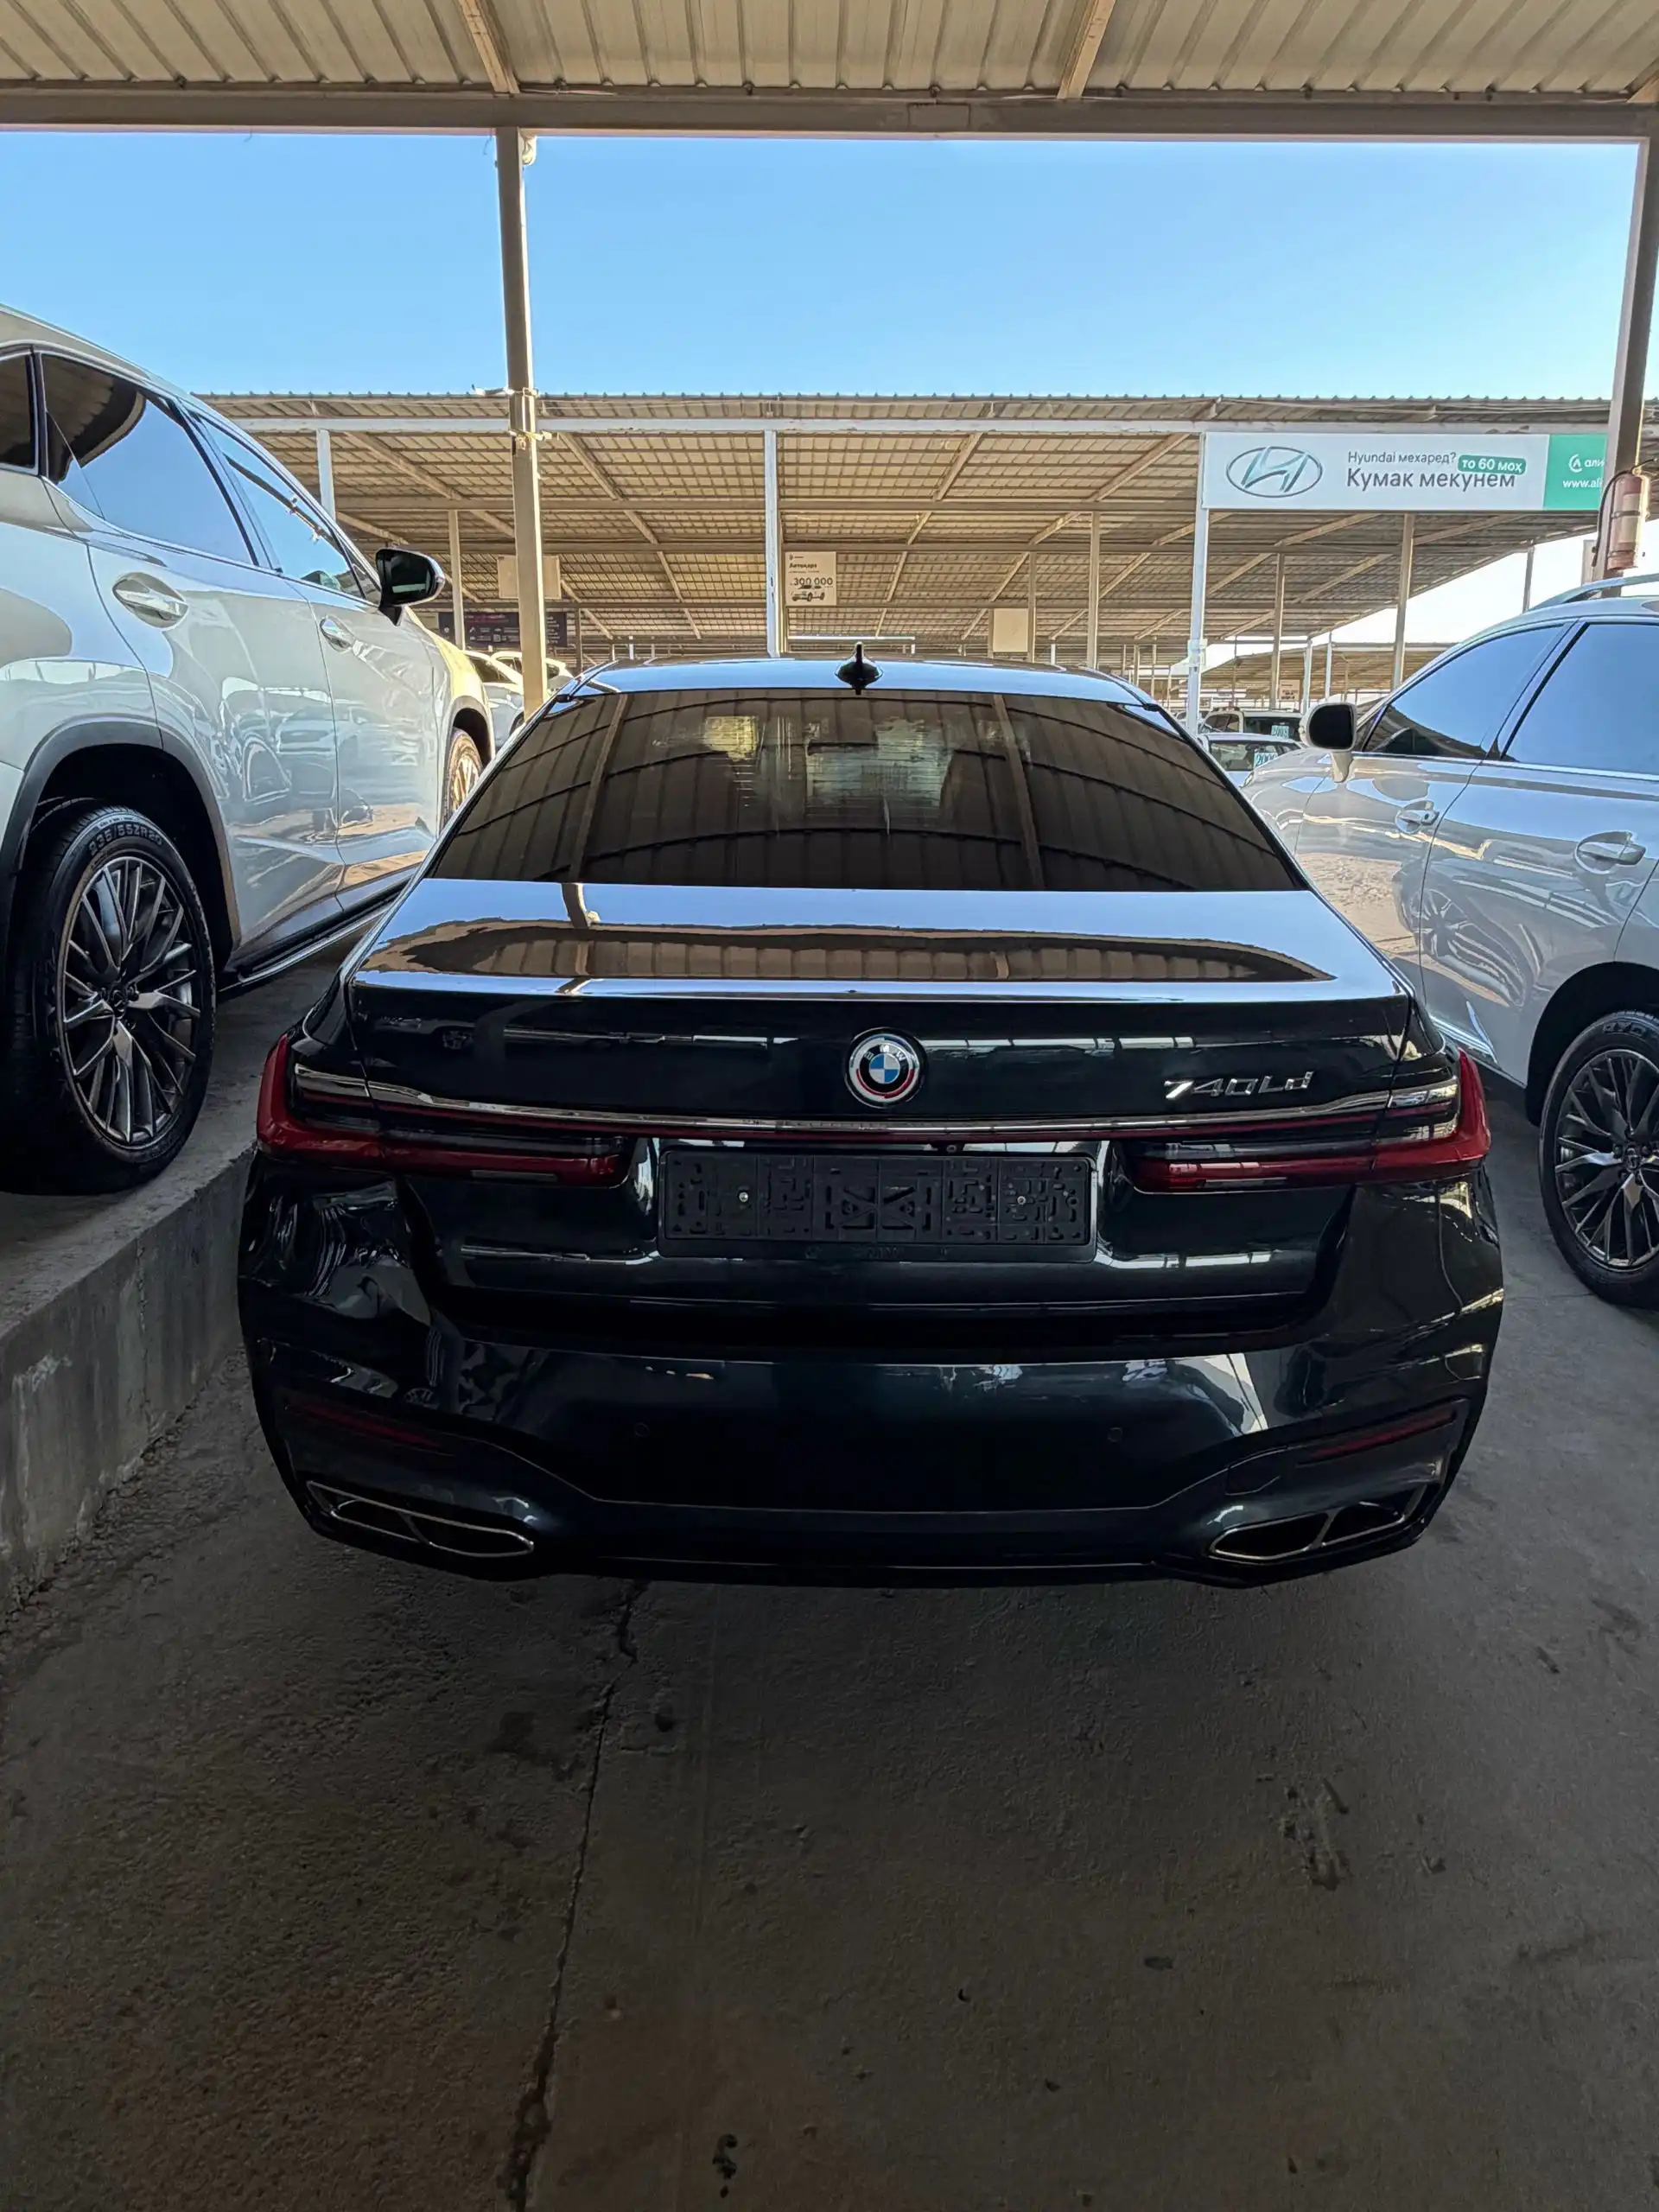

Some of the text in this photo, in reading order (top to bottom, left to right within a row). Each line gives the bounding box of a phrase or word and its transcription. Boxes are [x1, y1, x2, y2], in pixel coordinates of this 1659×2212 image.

[1347, 451, 1456, 465] Hyundai мехаред?
[1461, 459, 1476, 468] то
[1478, 458, 1495, 470] 60
[1347, 467, 1516, 492] Кумак мекунем
[863, 1044, 906, 1062] BMW
[1164, 1071, 1314, 1100] 740Ld
